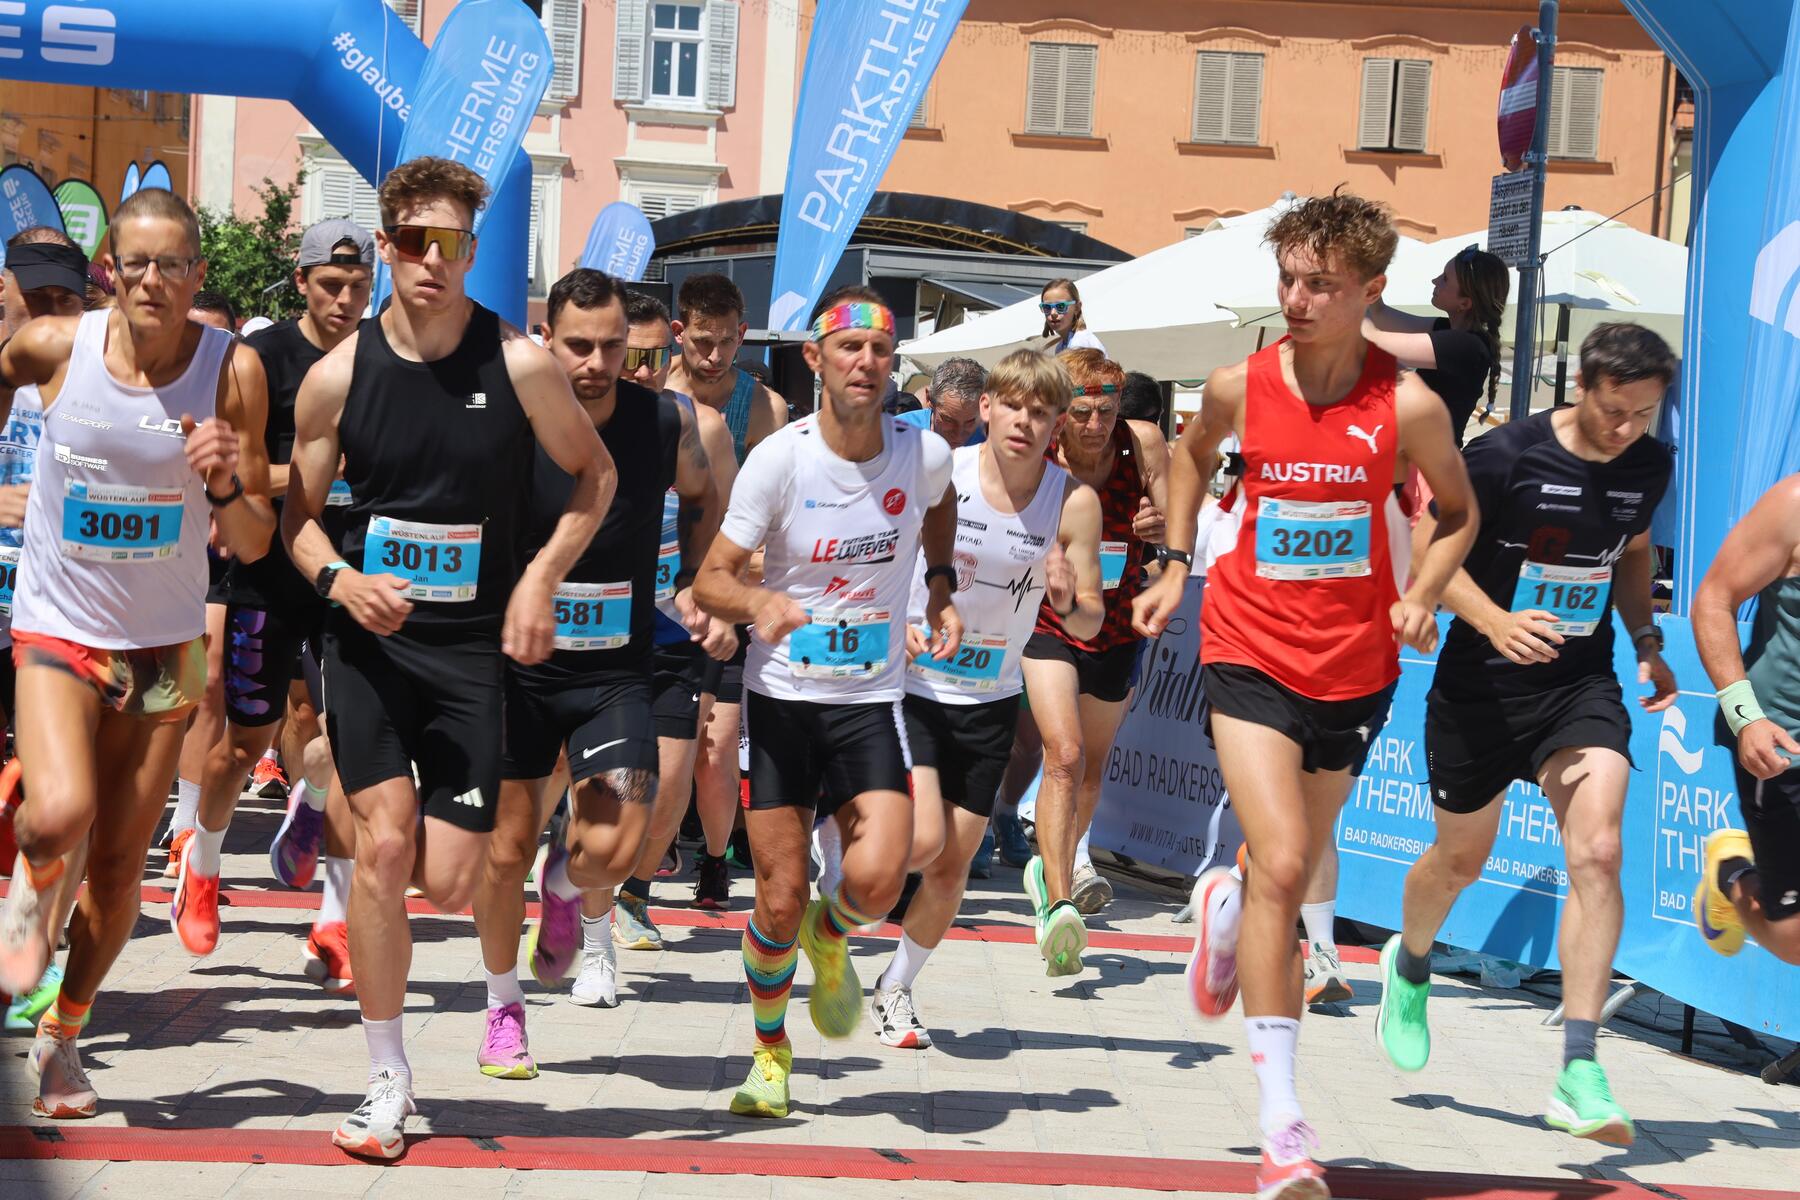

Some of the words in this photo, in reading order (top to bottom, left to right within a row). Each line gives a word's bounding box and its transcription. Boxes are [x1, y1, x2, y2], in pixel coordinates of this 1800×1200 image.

[472, 51, 540, 178] ERSBURG
[58, 413, 113, 431] TEAMSPORT
[70, 459, 107, 472] SOFTWARE
[1260, 462, 1369, 483] AUSTRIA
[80, 510, 160, 541] 3091
[381, 540, 463, 573] 3013
[1271, 528, 1353, 557] 3202
[412, 574, 429, 584] Jan
[1534, 583, 1598, 610] 1162
[554, 600, 605, 626] 581
[825, 628, 860, 654] 16
[1108, 745, 1143, 789] BAD
[1366, 736, 1415, 776] ARK
[1355, 774, 1436, 823] THERM
[1661, 780, 1734, 830] PARK
[1344, 826, 1368, 845] BAD
[1486, 856, 1510, 874] BAD
[1512, 860, 1570, 887] RADKERSB
[1659, 890, 1686, 911] BAD
